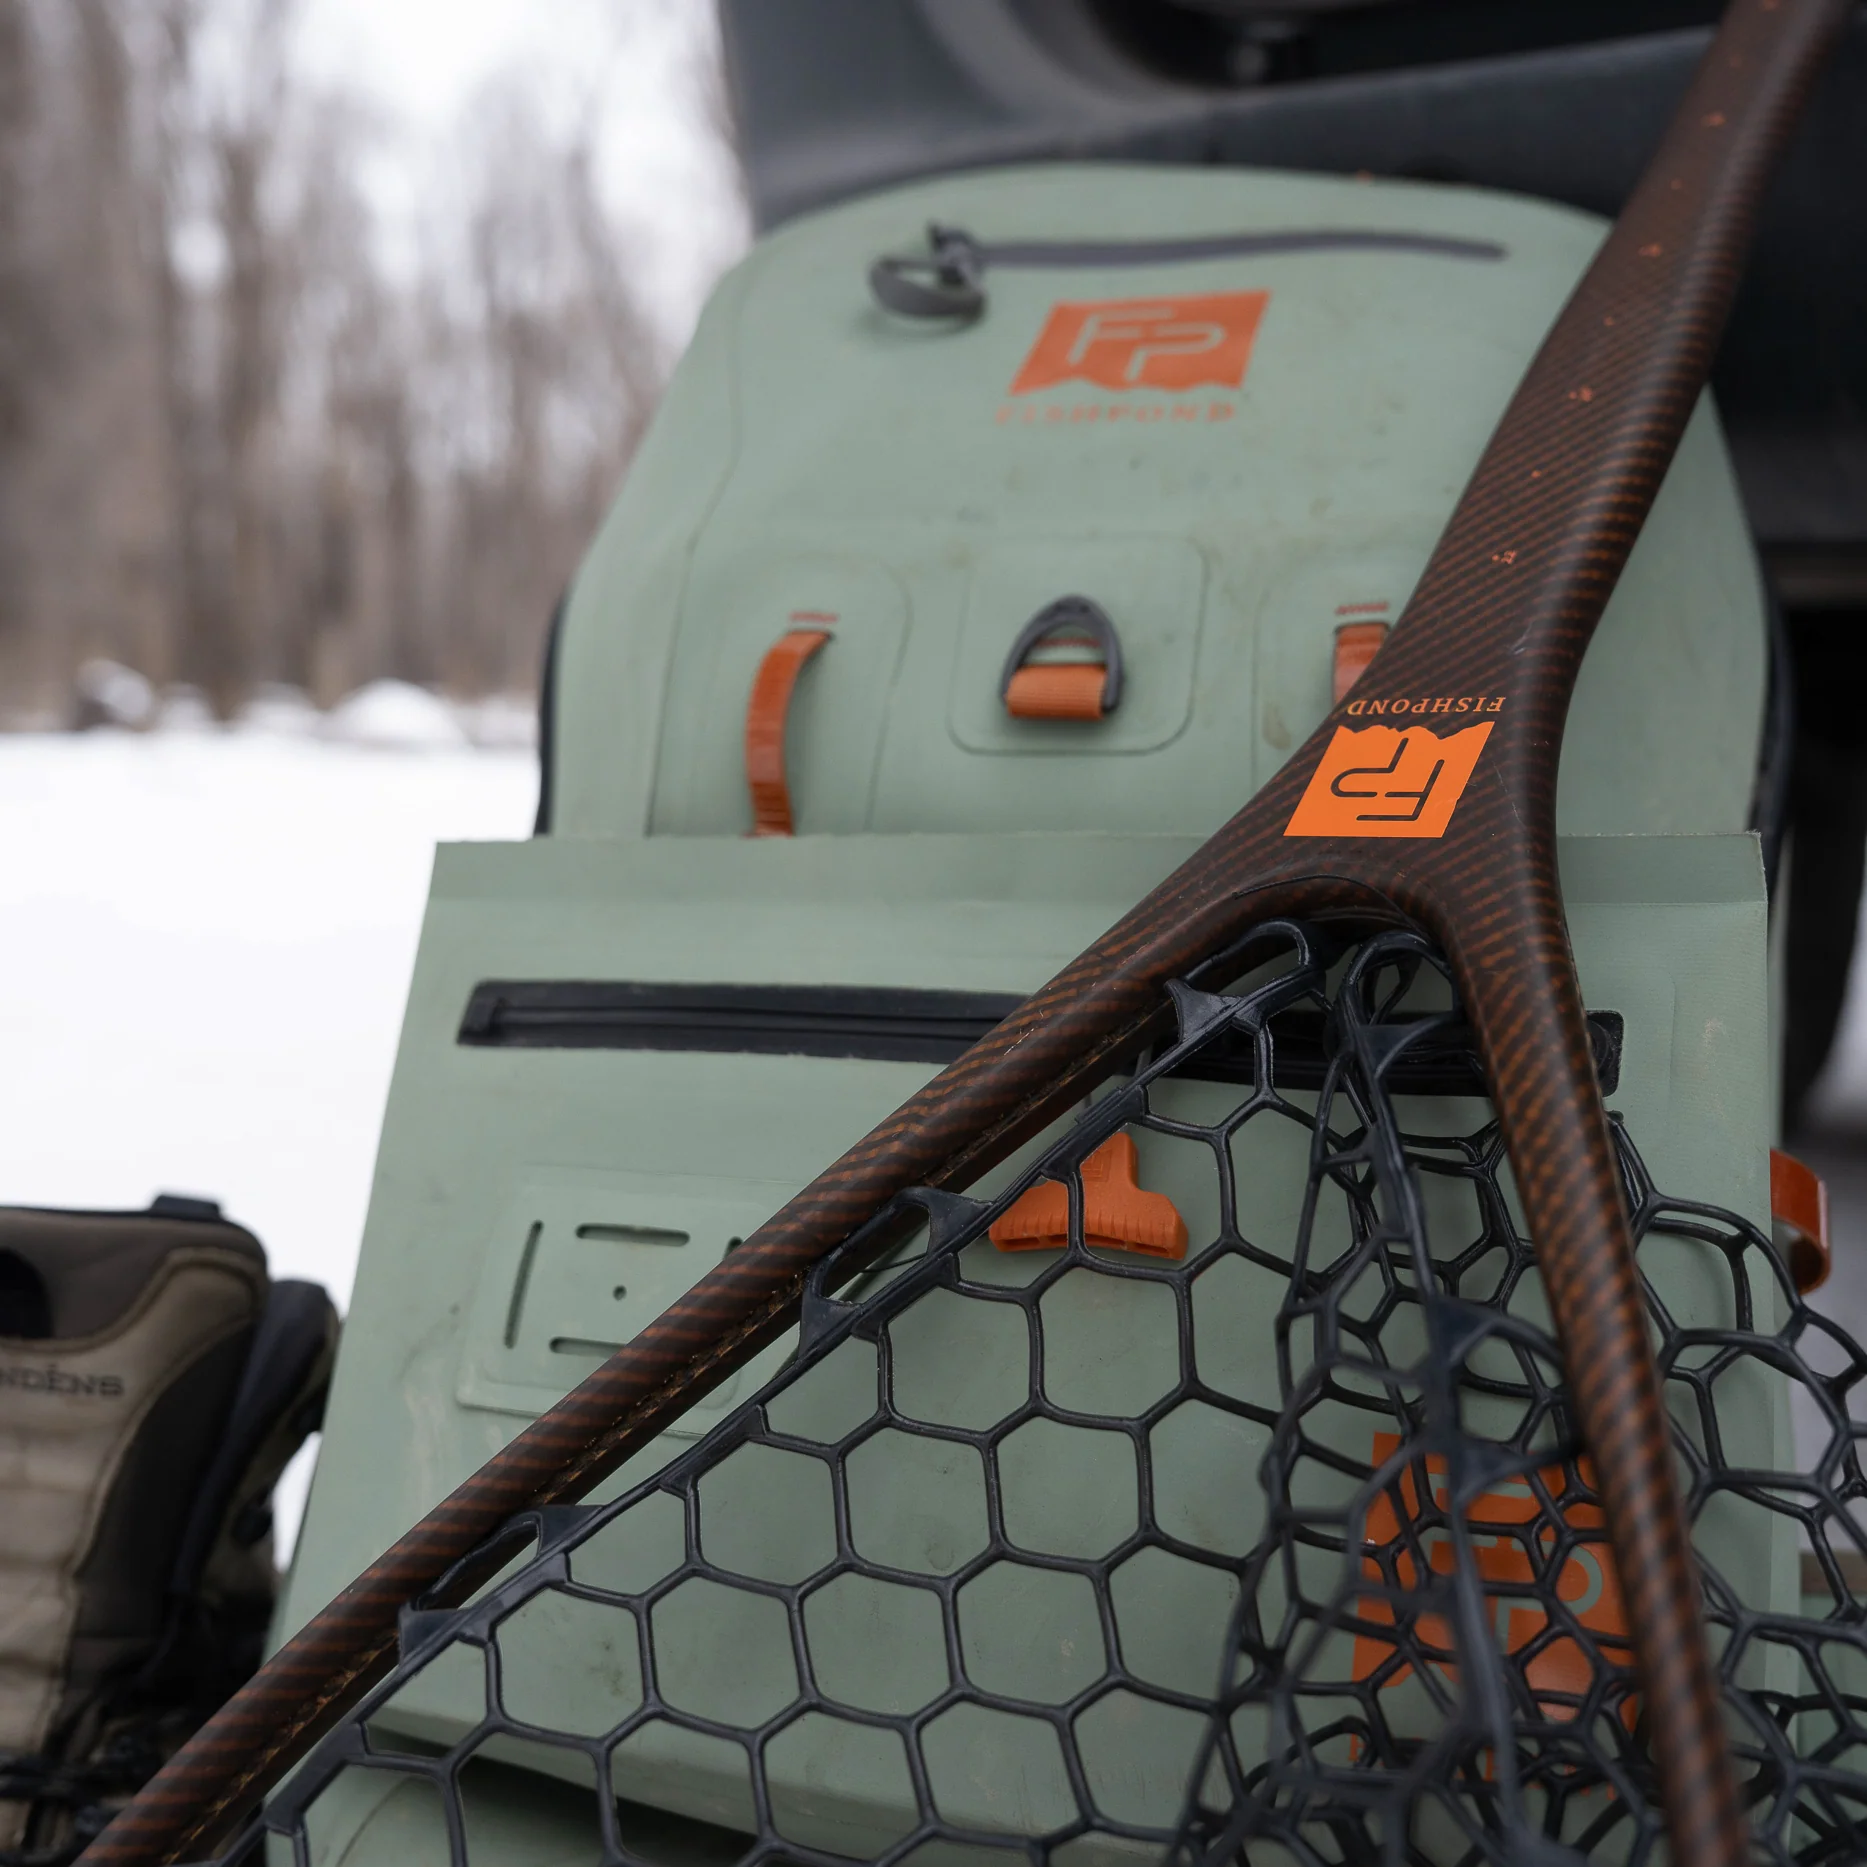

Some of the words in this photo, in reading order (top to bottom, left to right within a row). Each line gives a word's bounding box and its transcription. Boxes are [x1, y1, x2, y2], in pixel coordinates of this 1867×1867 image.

[1066, 307, 1227, 382] FP
[1347, 696, 1506, 715] FISHPOND
[1331, 737, 1445, 821] FP
